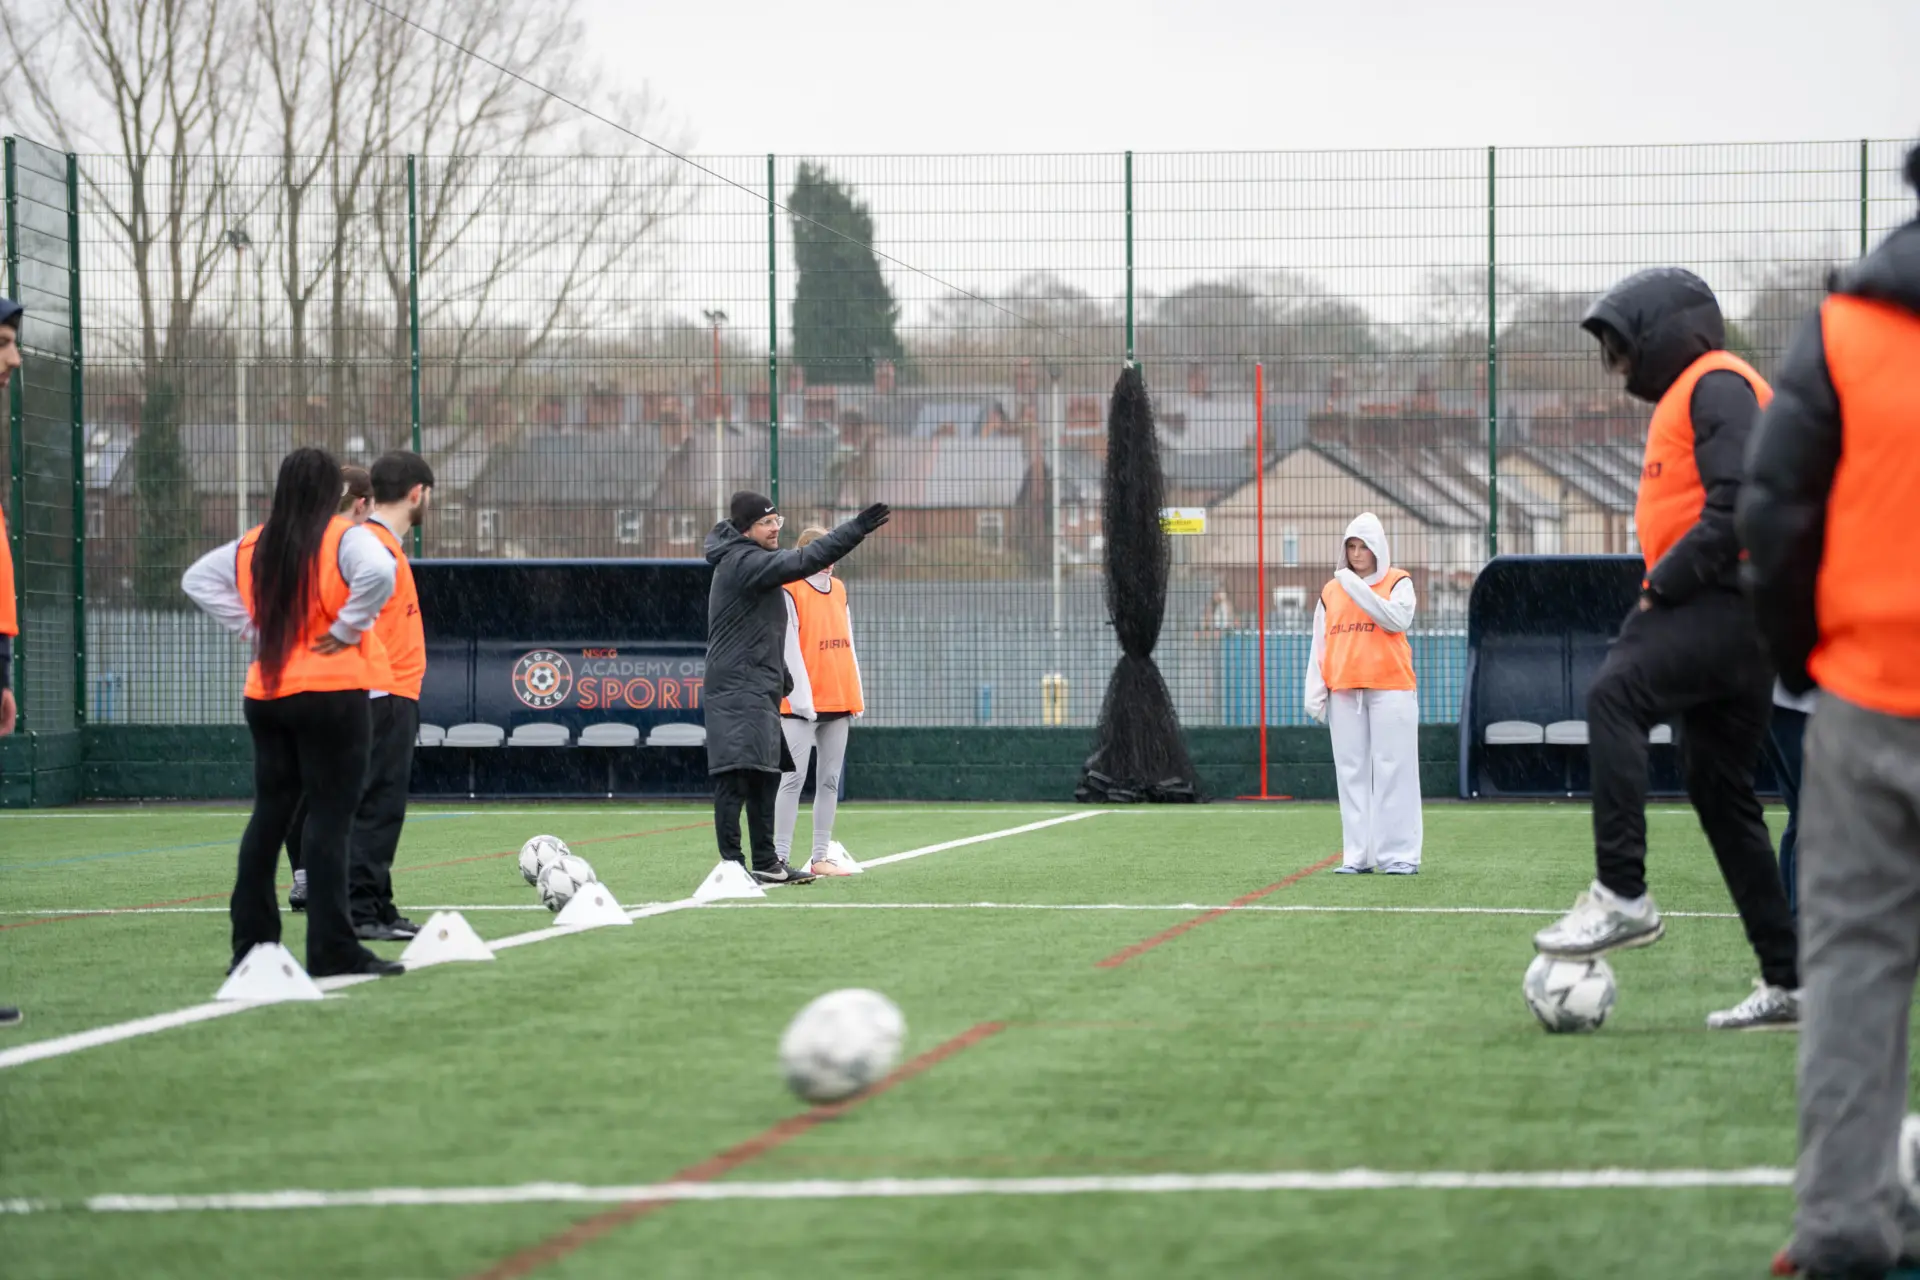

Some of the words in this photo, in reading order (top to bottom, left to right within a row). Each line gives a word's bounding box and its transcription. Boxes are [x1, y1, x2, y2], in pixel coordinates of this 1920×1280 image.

[523, 653, 563, 668] AGFA
[582, 649, 617, 659] NSCG
[579, 662, 673, 676] ACADEMY
[679, 662, 705, 676] OF
[523, 691, 563, 706] NSCG
